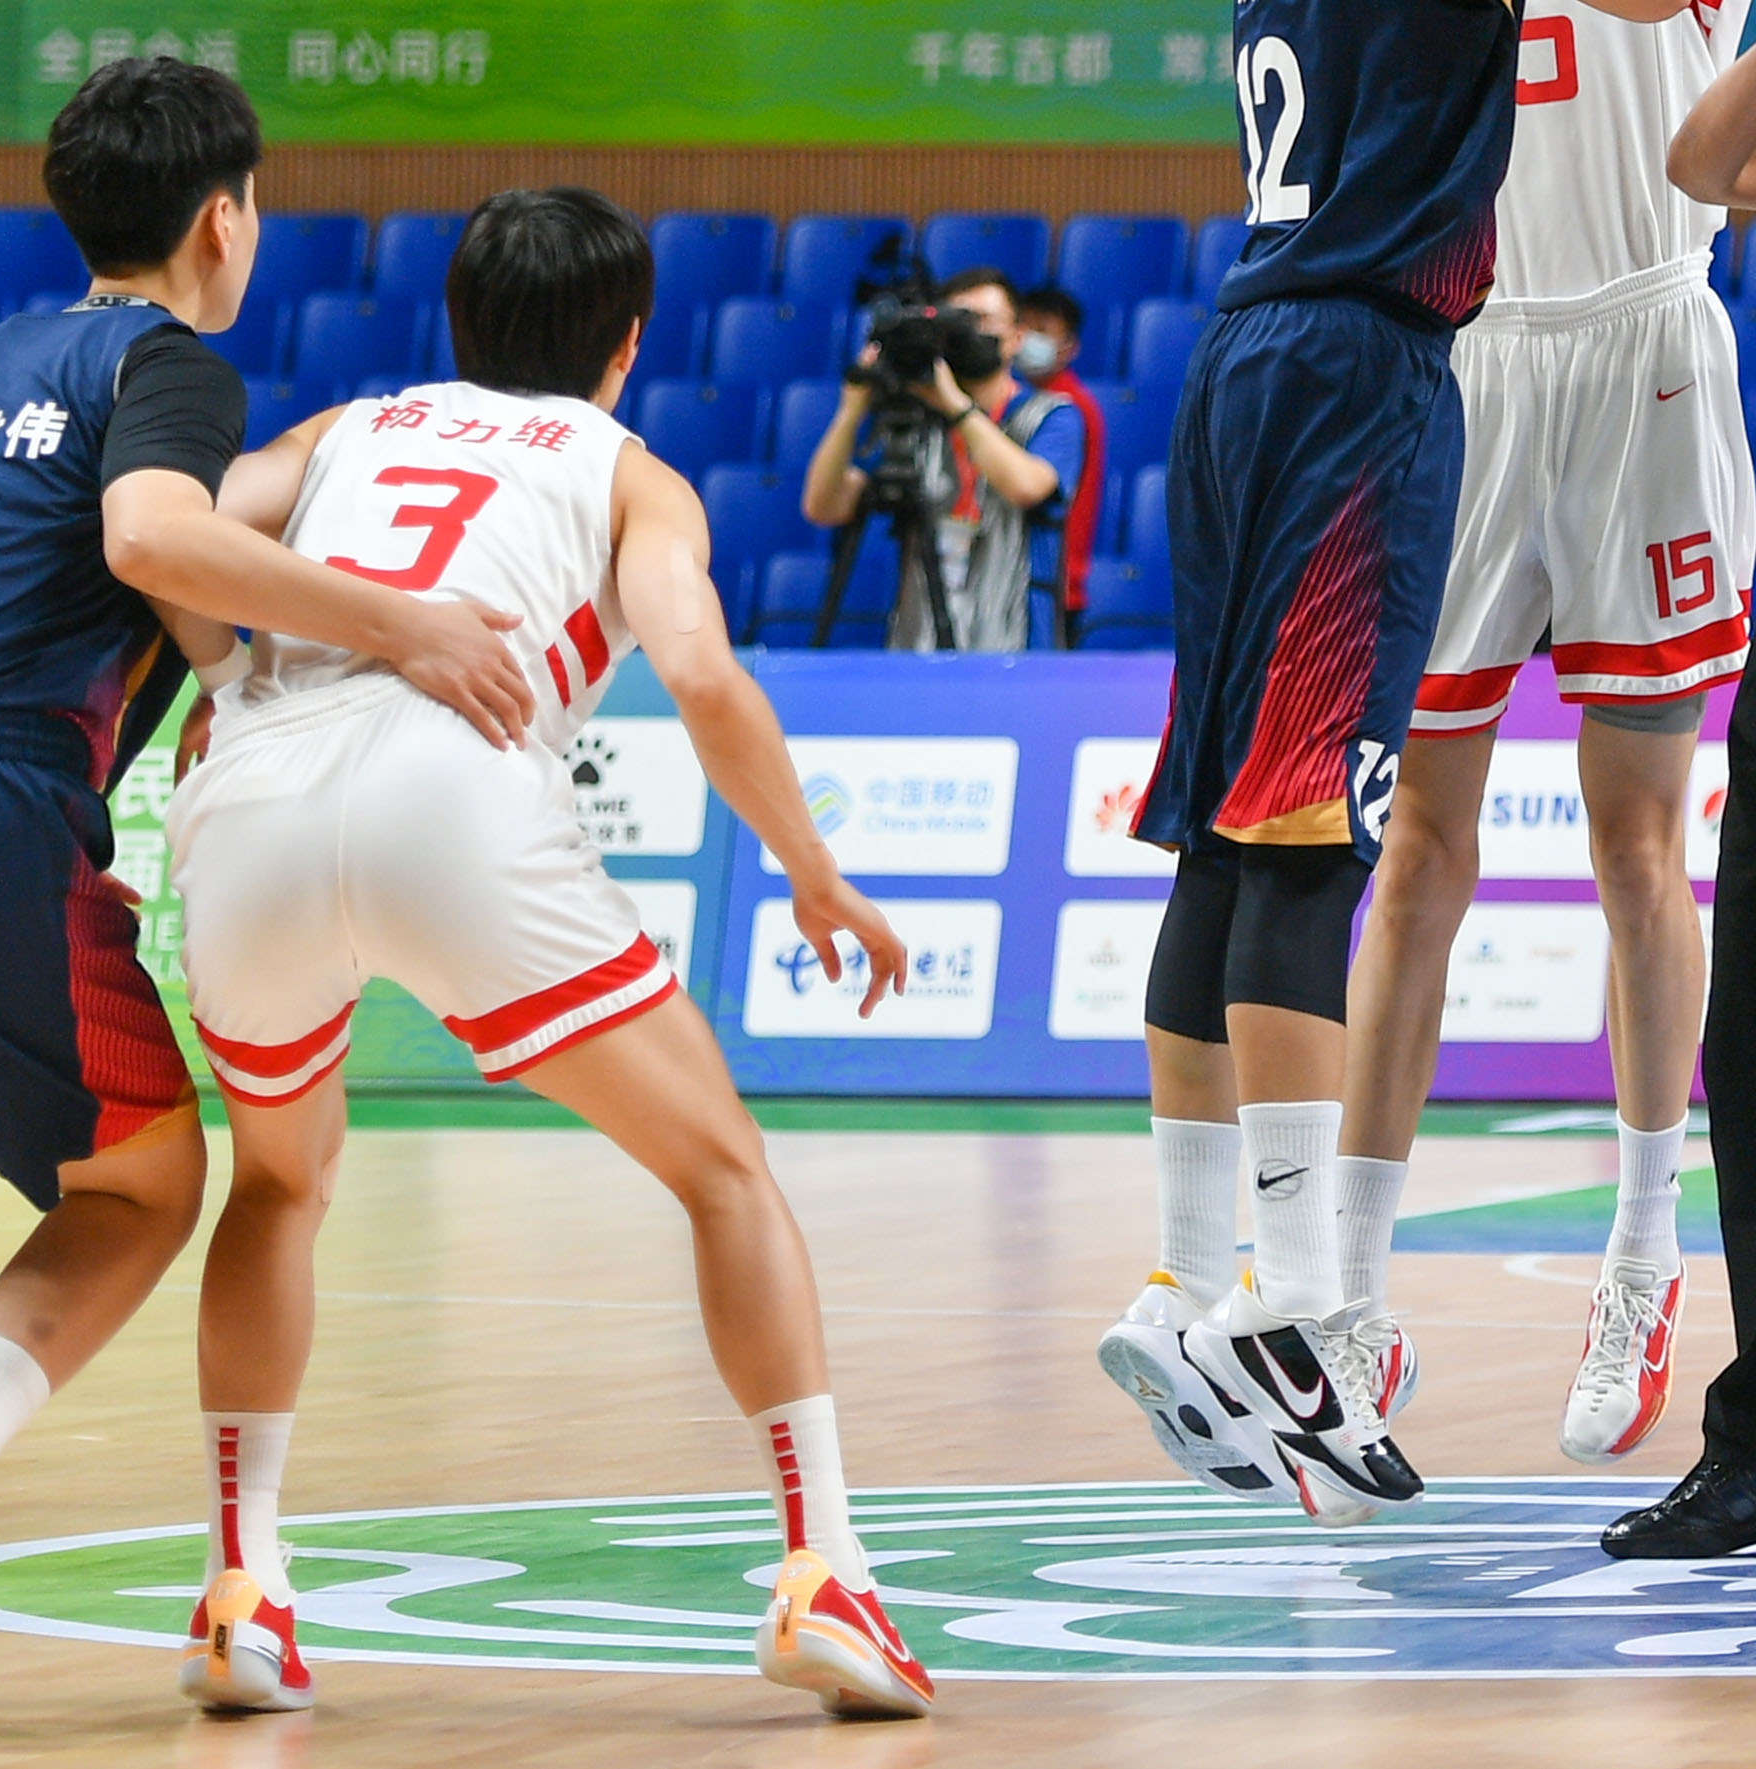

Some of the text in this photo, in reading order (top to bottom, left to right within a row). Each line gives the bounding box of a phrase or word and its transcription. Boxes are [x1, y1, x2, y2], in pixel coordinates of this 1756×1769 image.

[288, 30, 491, 86] 同心同行
[909, 32, 1112, 86] 千年古都
[1237, 36, 1311, 225] 12
[371, 400, 578, 453] 杨力维
[325, 465, 500, 593] 3
[1645, 530, 1716, 620] 15
